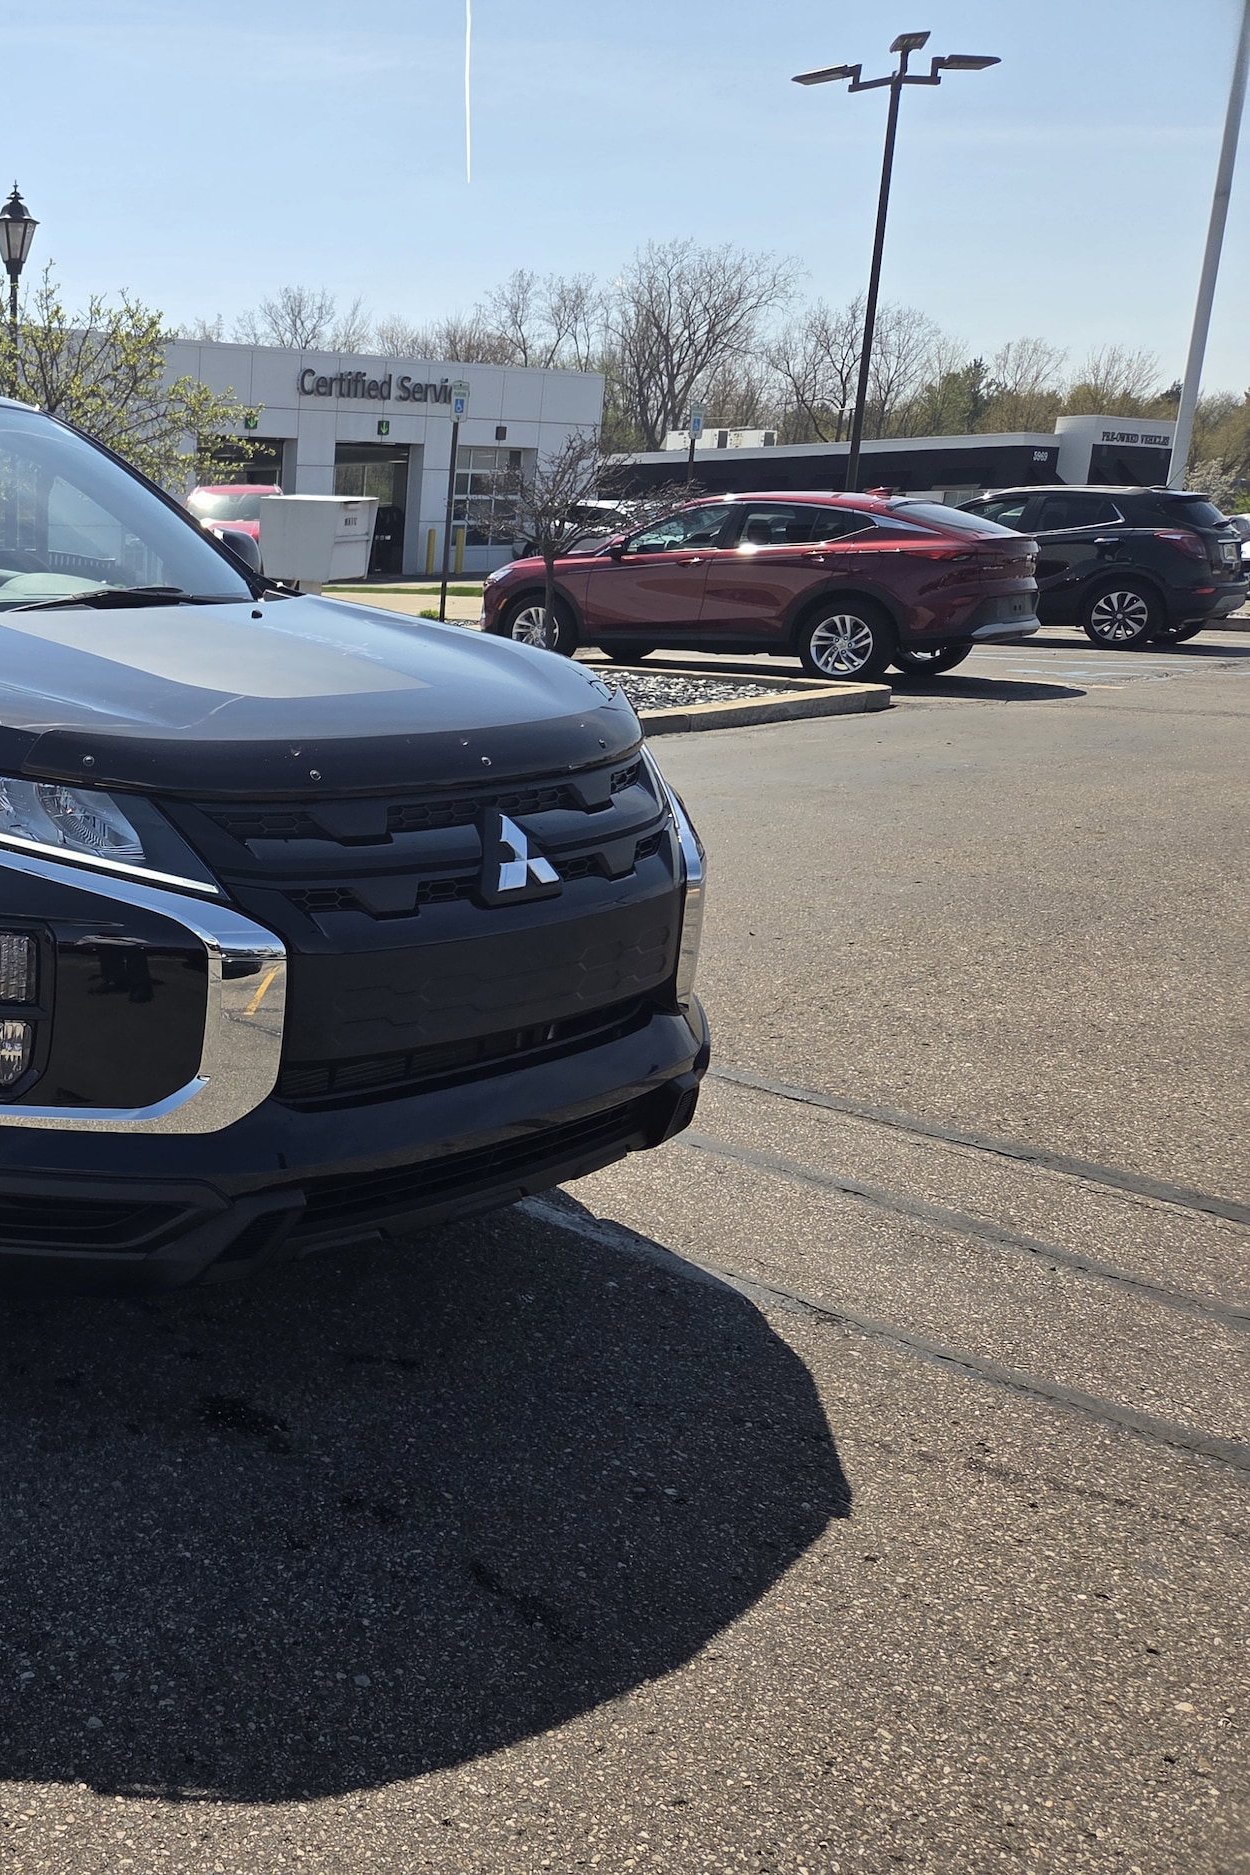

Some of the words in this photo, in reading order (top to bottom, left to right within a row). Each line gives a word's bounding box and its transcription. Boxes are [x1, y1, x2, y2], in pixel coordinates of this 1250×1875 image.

[300, 368, 393, 401] Certified
[398, 376, 453, 404] Servi
[1101, 431, 1139, 444] PRE-OWNED
[1140, 434, 1170, 446] VEHICLES
[1033, 450, 1049, 462] 5969
